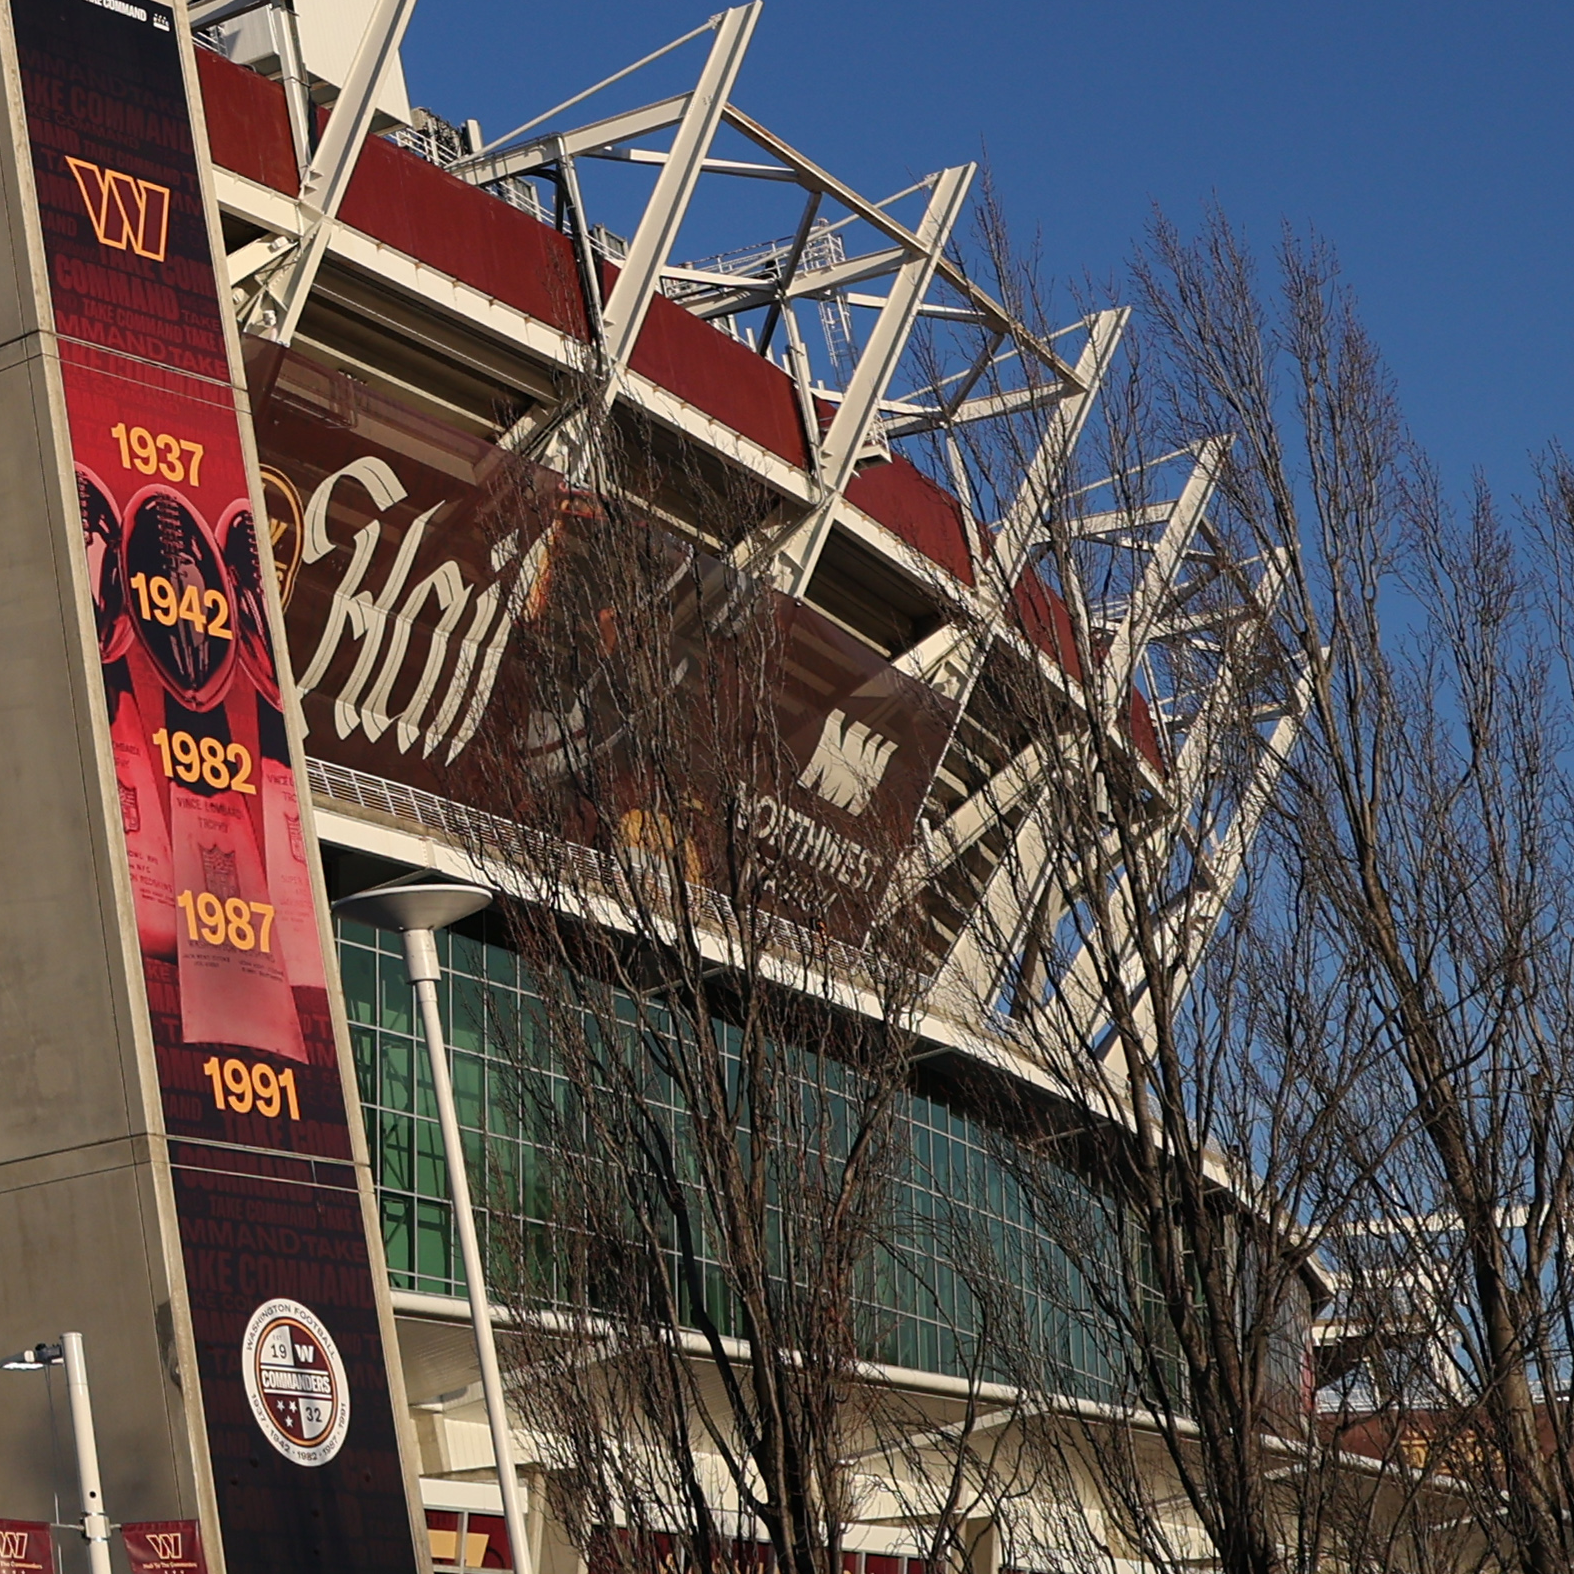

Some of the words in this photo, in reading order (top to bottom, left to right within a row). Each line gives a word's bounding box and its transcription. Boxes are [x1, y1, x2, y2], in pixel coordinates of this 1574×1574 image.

[111, 422, 204, 487] 1937
[131, 572, 233, 640] 1942
[153, 727, 257, 795] 1982
[177, 889, 275, 953] 1987
[203, 1056, 301, 1121] 1991
[246, 1303, 291, 1351] WASHINGTON
[294, 1307, 335, 1360] FOOTBALL
[271, 1344, 287, 1359] 19
[294, 1343, 315, 1364] W
[261, 1369, 331, 1394] COMMANDERS
[305, 1406, 323, 1423] 32
[297, 1451, 319, 1461] 1982
